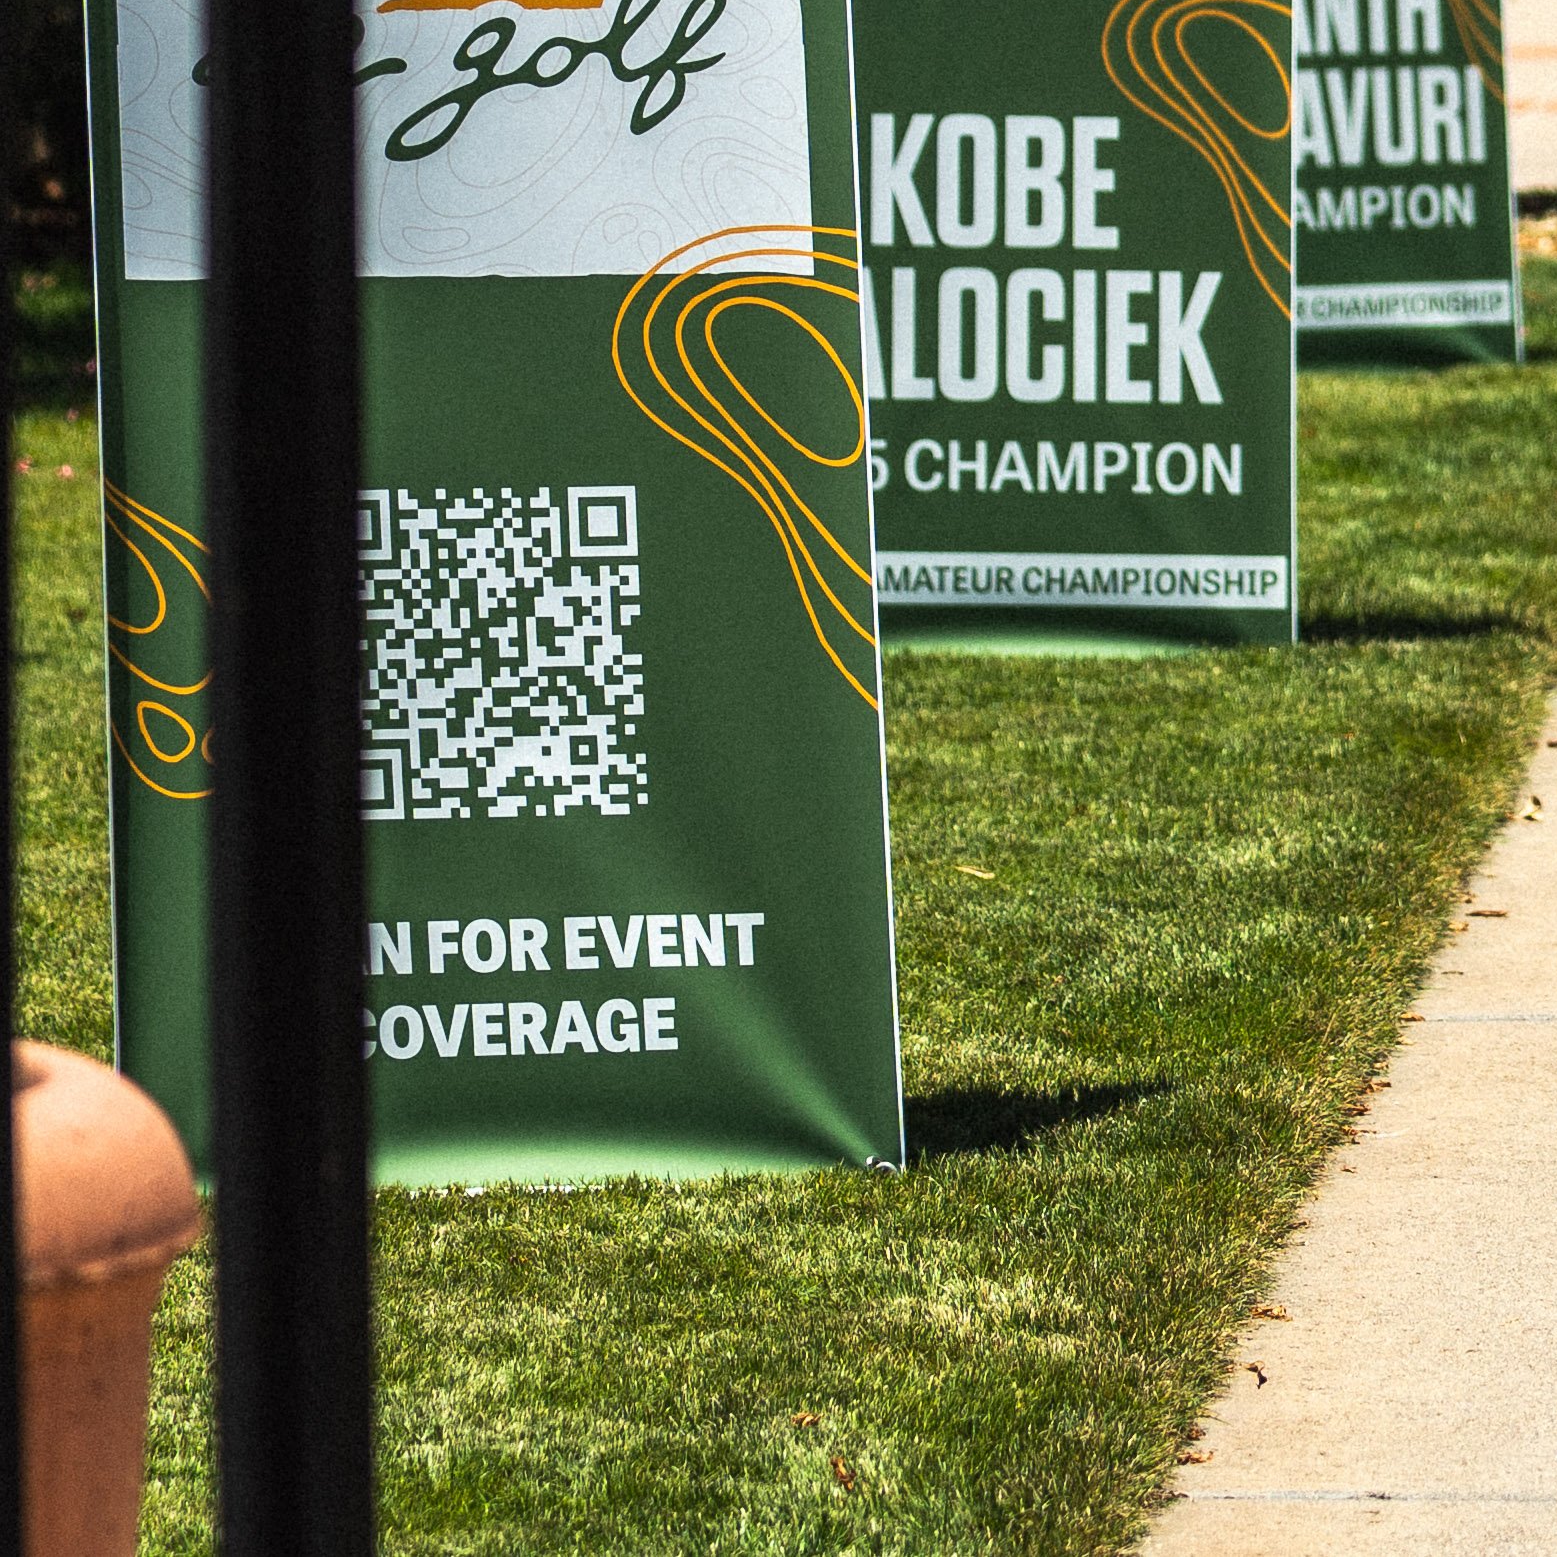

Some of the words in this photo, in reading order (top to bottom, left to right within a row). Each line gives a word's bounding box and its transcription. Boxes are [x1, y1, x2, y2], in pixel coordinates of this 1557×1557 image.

[870, 112, 1121, 250] KOBE
[1310, 292, 1503, 320] CHAMPIONSHIP
[903, 439, 1243, 495] CHAMPION
[876, 564, 1014, 595] MATEUR
[1021, 567, 1279, 598] CHAMPIONSHIP
[427, 918, 550, 975] FOR
[565, 913, 765, 970] EVENT
